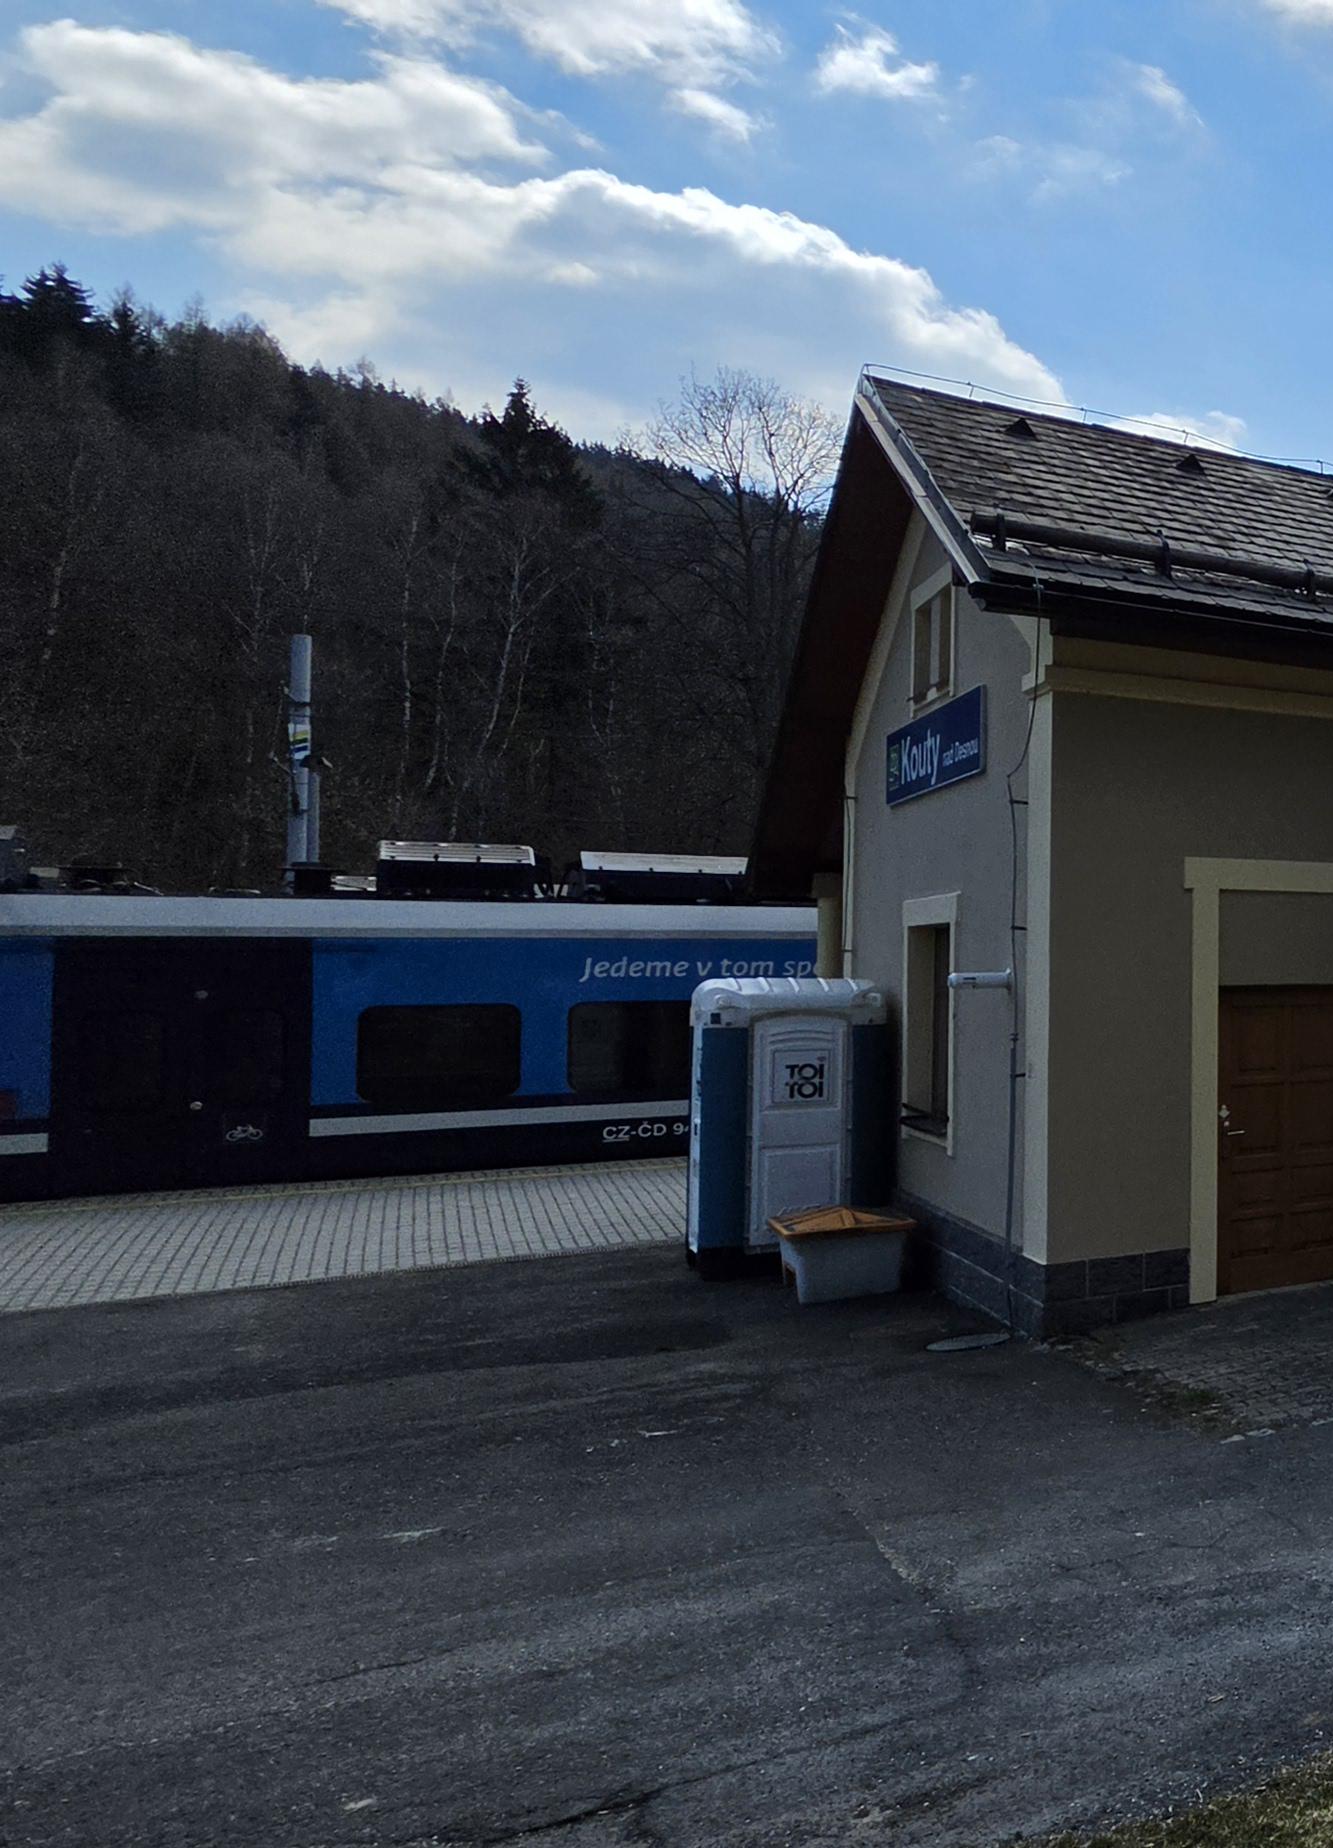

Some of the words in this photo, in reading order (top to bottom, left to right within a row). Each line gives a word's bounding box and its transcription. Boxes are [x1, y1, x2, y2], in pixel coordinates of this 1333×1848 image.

[901, 728, 940, 785] Kouty
[579, 956, 690, 983] Jedeme
[696, 961, 712, 977] v
[720, 958, 774, 977] tom
[785, 1063, 824, 1081] TOI
[785, 1074, 823, 1099] TOI
[602, 1120, 667, 1142] CZ-ČD
[673, 1122, 689, 1135] 9
